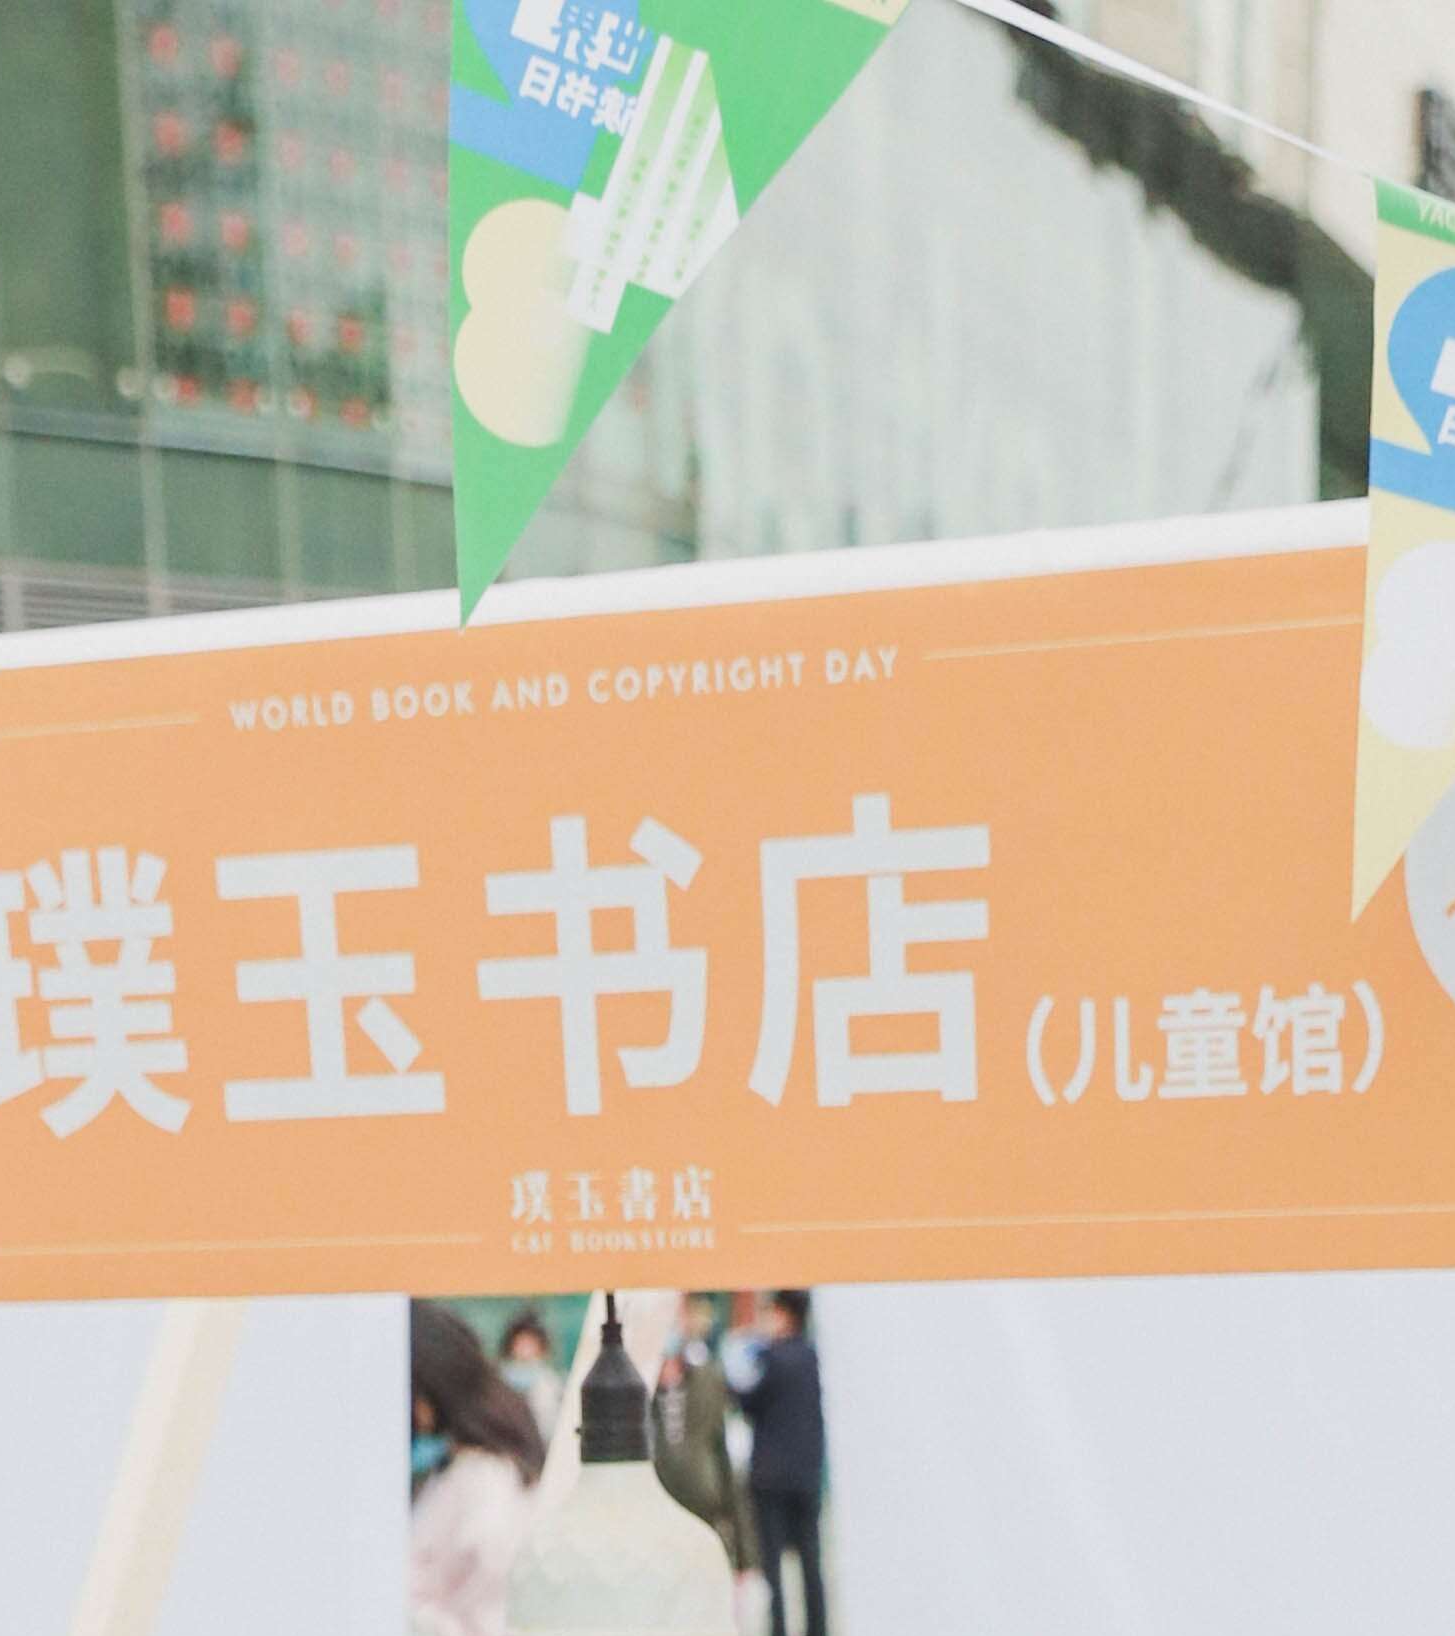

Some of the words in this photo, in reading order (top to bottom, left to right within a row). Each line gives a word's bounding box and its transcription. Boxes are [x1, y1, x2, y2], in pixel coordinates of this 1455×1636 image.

[228, 690, 354, 732] WORLD
[371, 683, 474, 724] BOOK
[490, 674, 571, 712] AND
[587, 651, 806, 705] COPYRIGHT
[825, 645, 900, 684] DAY
